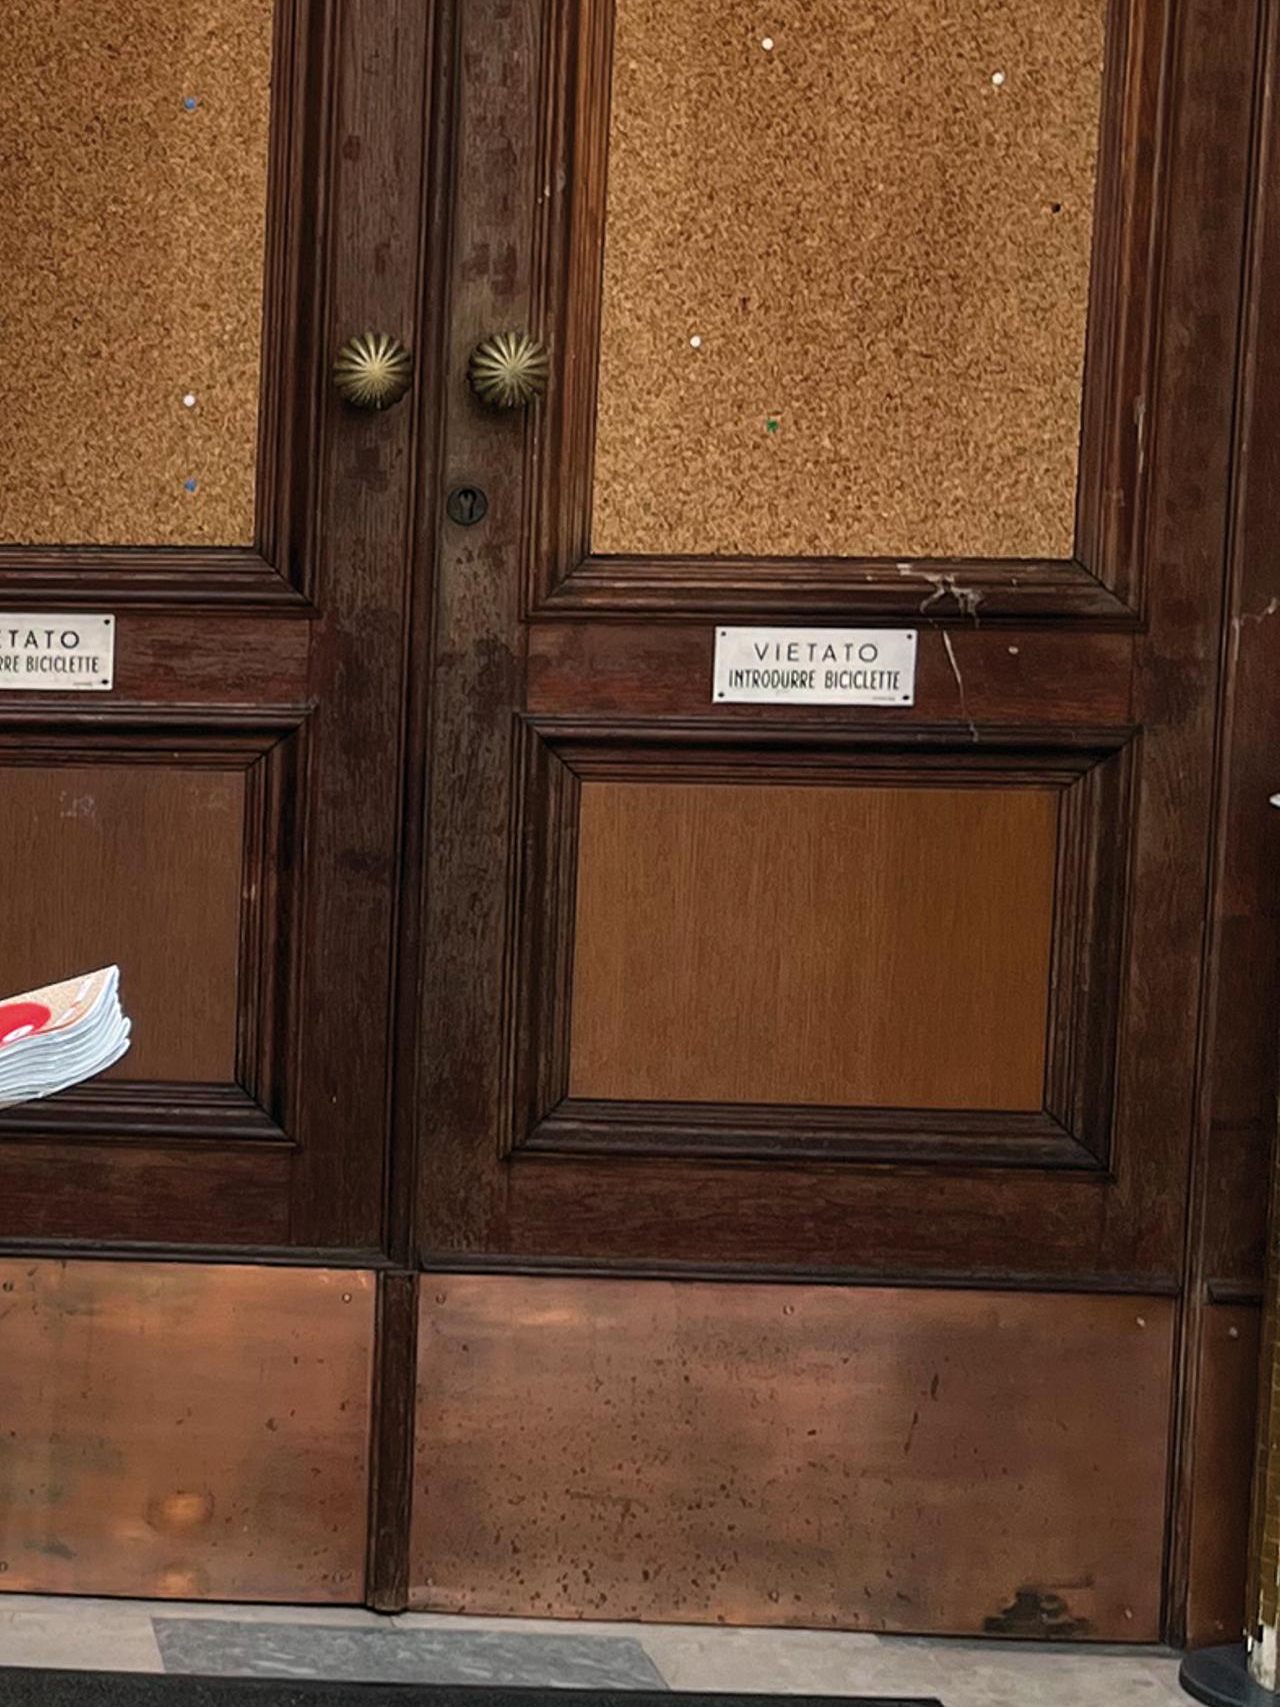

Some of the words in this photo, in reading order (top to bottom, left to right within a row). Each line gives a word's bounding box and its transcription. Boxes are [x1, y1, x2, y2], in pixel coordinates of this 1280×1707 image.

[754, 642, 879, 663] VIETATO
[26, 656, 100, 673] BICICLETTE
[728, 669, 816, 689] INTRODURRE
[824, 670, 900, 690] BICICLETTE
